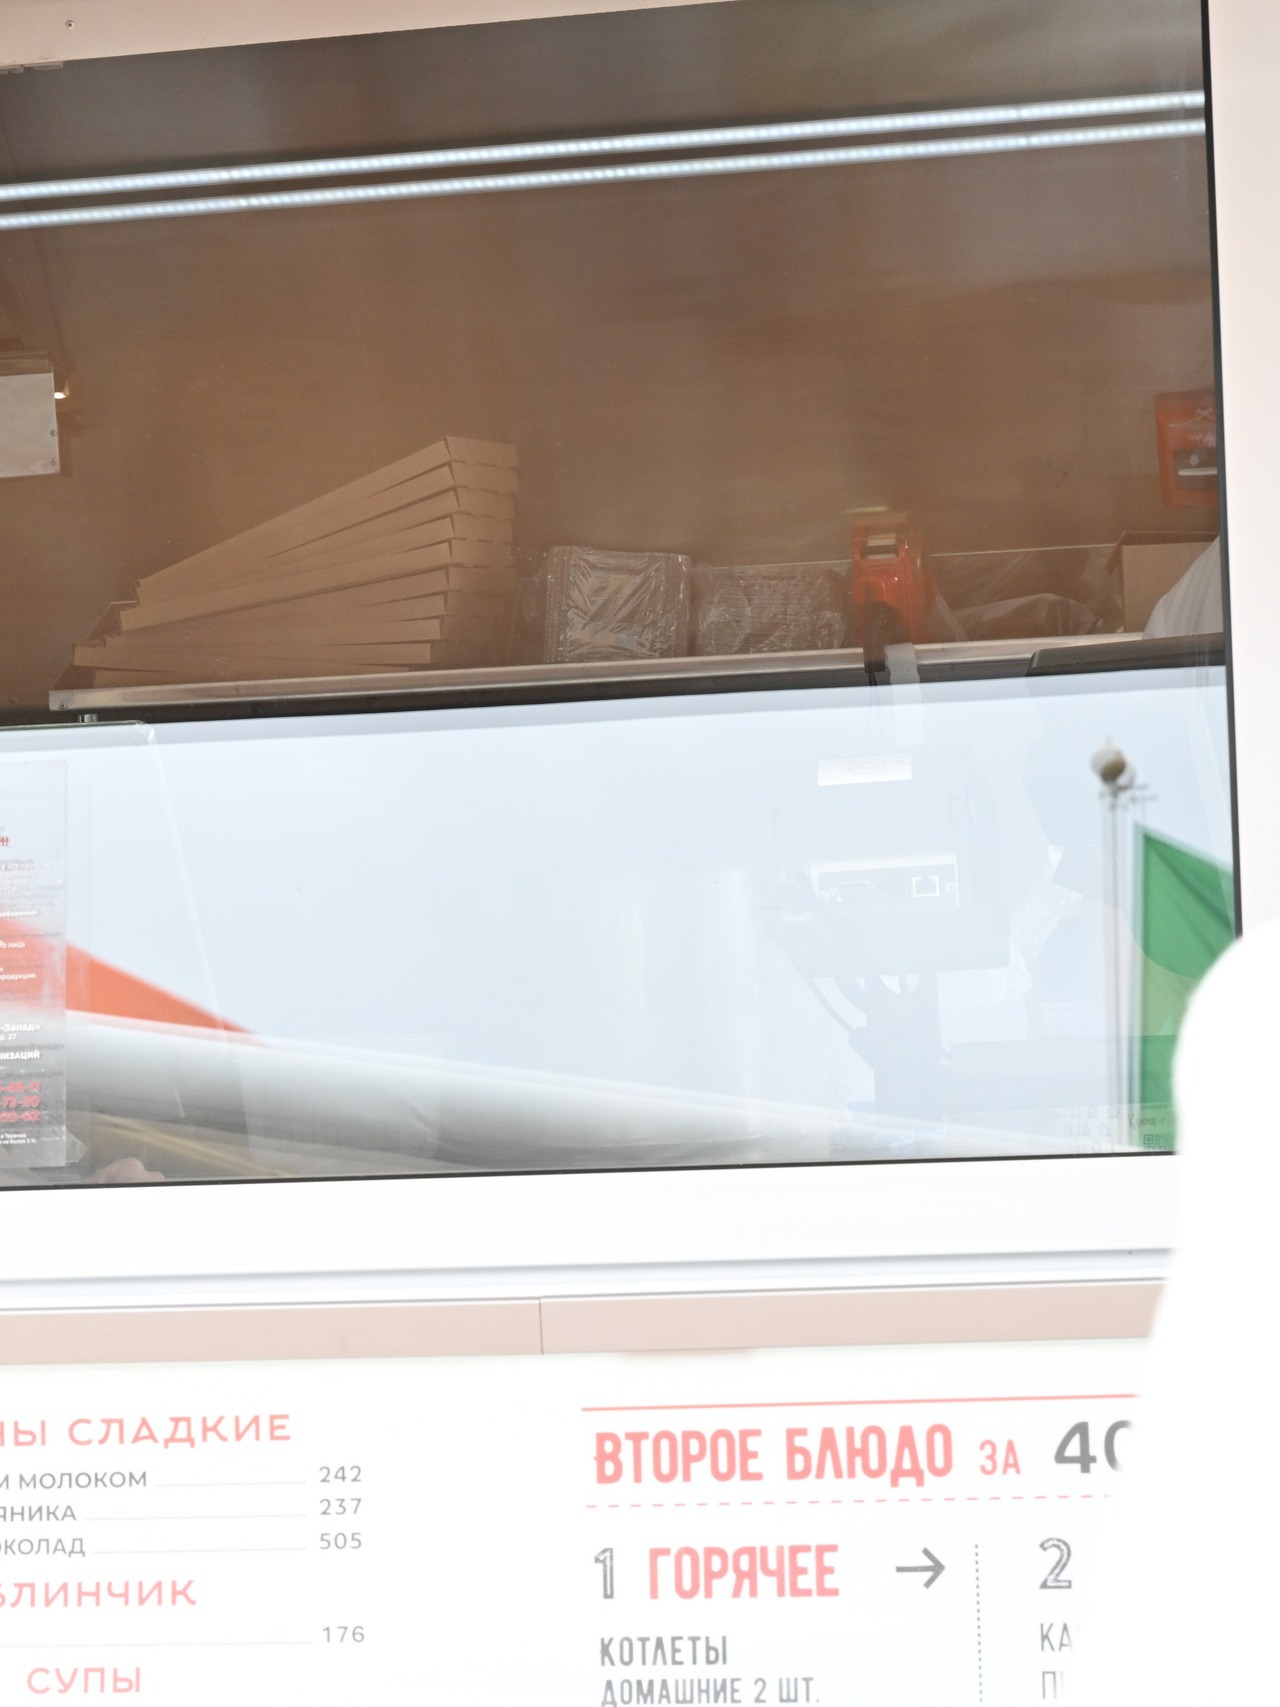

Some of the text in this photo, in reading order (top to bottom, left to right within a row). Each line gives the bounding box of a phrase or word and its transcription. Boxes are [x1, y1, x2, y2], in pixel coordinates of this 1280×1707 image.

[68, 1414, 291, 1449] СЛАДКИЕ
[593, 1428, 763, 1484] ВТОРОЕ
[785, 1423, 953, 1488] БЛЮДО
[979, 1439, 1021, 1476] ЗА
[19, 1471, 146, 1489] МОЛОКОМ
[319, 1465, 361, 1483] 242
[320, 1498, 361, 1515] 237
[320, 1532, 361, 1550] 505
[594, 1537, 1072, 1600] 1 ГОРЯЧЕЕ 2
[323, 1626, 364, 1643] 176
[599, 1622, 1080, 1666] КОТЛЕТЫ КА
[27, 1667, 140, 1694] СУПЫ
[601, 1678, 742, 1707] ДОМАШНИЕ
[754, 1678, 766, 1703] 2
[779, 1677, 819, 1703] ШТ.
